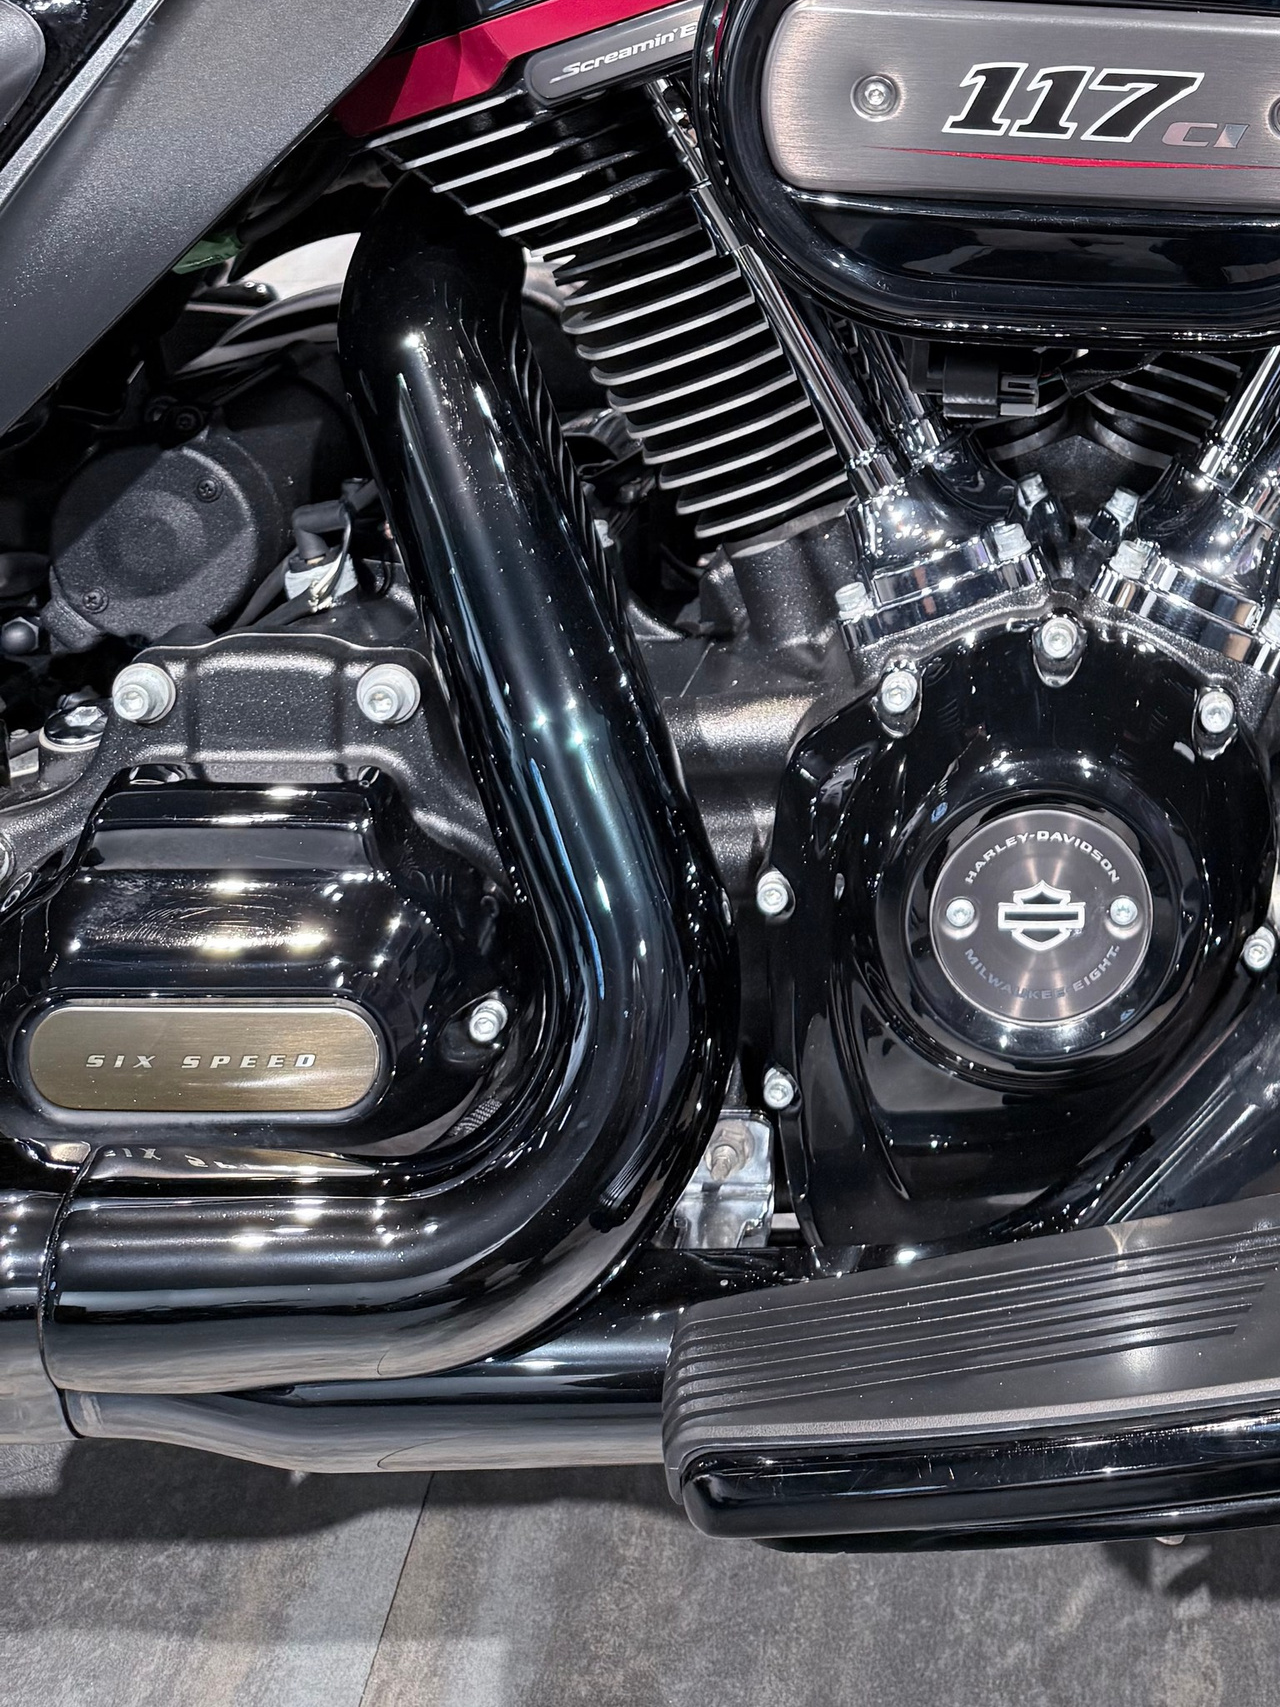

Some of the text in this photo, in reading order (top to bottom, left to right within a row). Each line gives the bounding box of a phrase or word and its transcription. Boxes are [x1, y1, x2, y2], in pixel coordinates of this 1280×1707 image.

[549, 28, 678, 84] Screamin'
[941, 61, 1250, 149] 117 CI
[964, 829, 1121, 885] HARLEY-DAVIDSON
[86, 1052, 317, 1069] SIX SPEED
